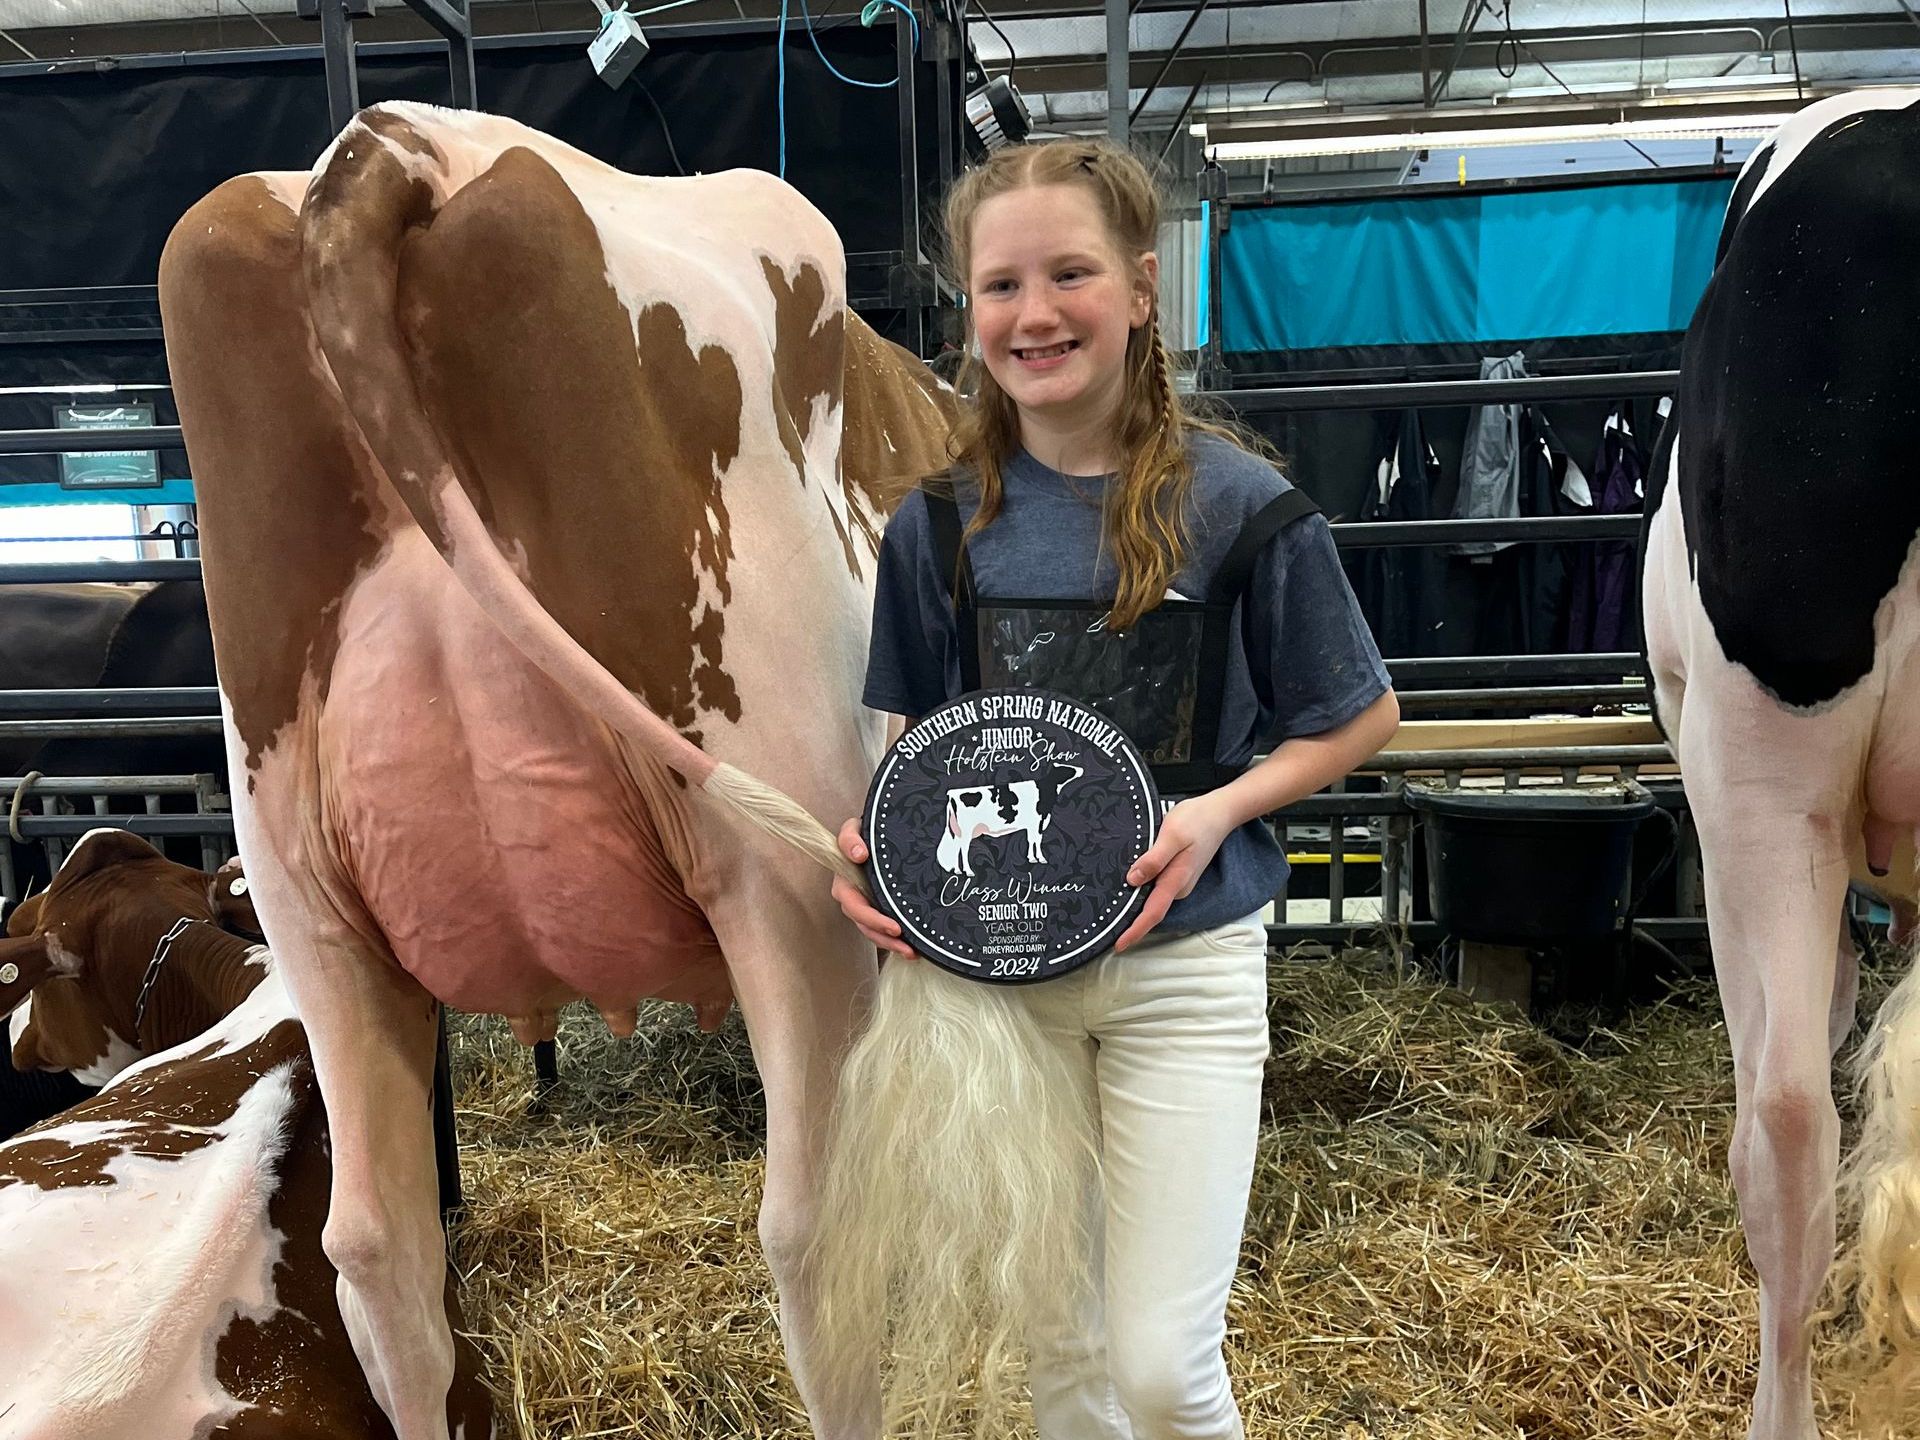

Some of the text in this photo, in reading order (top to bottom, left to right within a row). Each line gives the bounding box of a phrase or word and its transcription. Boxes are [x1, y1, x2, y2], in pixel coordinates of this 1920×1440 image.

[896, 695, 1124, 760] SOUTHERN SPRING NATIONAL
[980, 726, 1033, 750] JUNIOR
[943, 738, 1080, 776] Holstein Show
[940, 871, 1086, 907] Class Winner
[978, 902, 1048, 921] SENIOR TWO
[983, 920, 1044, 934] YEAR OLD
[982, 944, 1047, 954] ROKEYROAD DAIRY
[988, 935, 1028, 944] SPONSORED
[990, 956, 1041, 976] 2024
